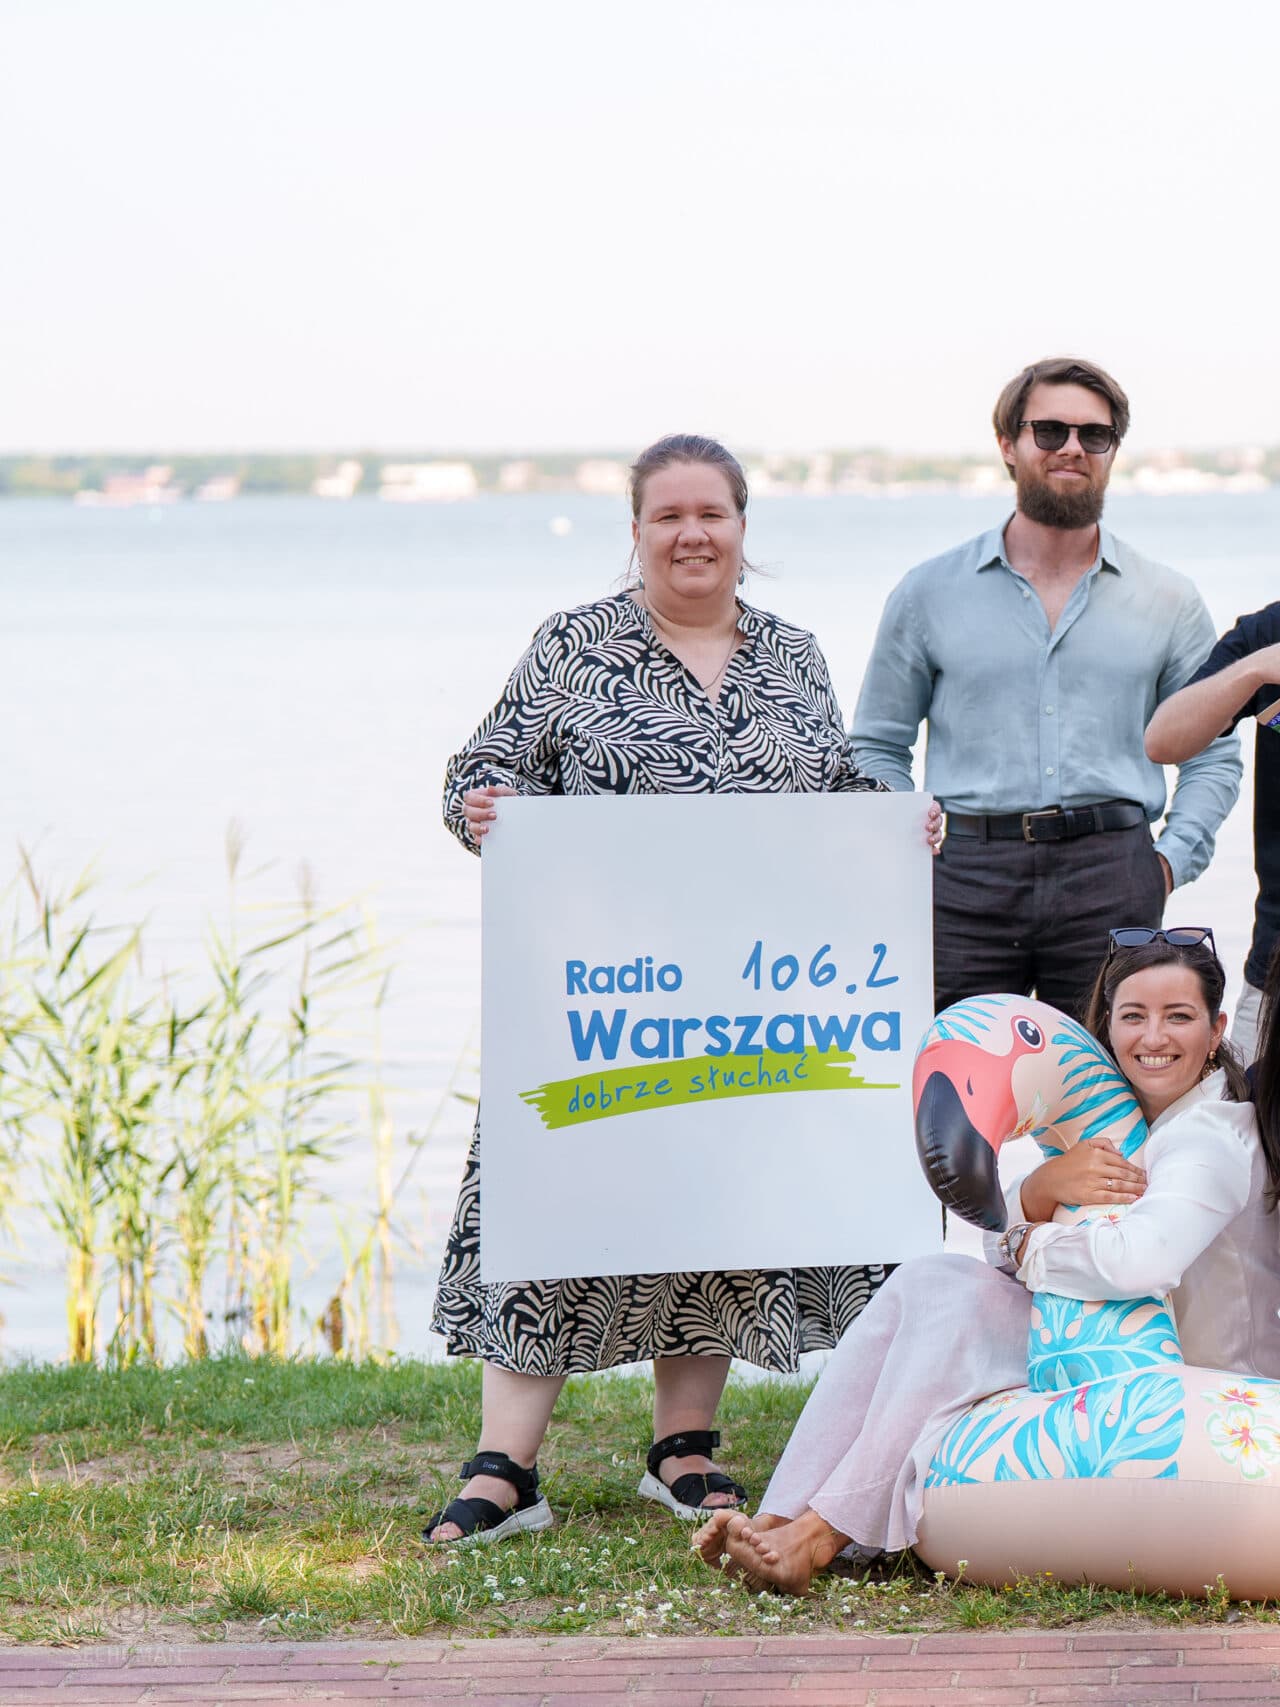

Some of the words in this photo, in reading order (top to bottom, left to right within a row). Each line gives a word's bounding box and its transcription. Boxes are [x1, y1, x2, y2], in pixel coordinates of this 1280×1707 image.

[566, 956, 683, 995] Radio
[742, 940, 899, 994] 106.2
[566, 1008, 901, 1061] Warszawa
[567, 1076, 673, 1113] dobrze
[688, 1053, 809, 1094] słuchać
